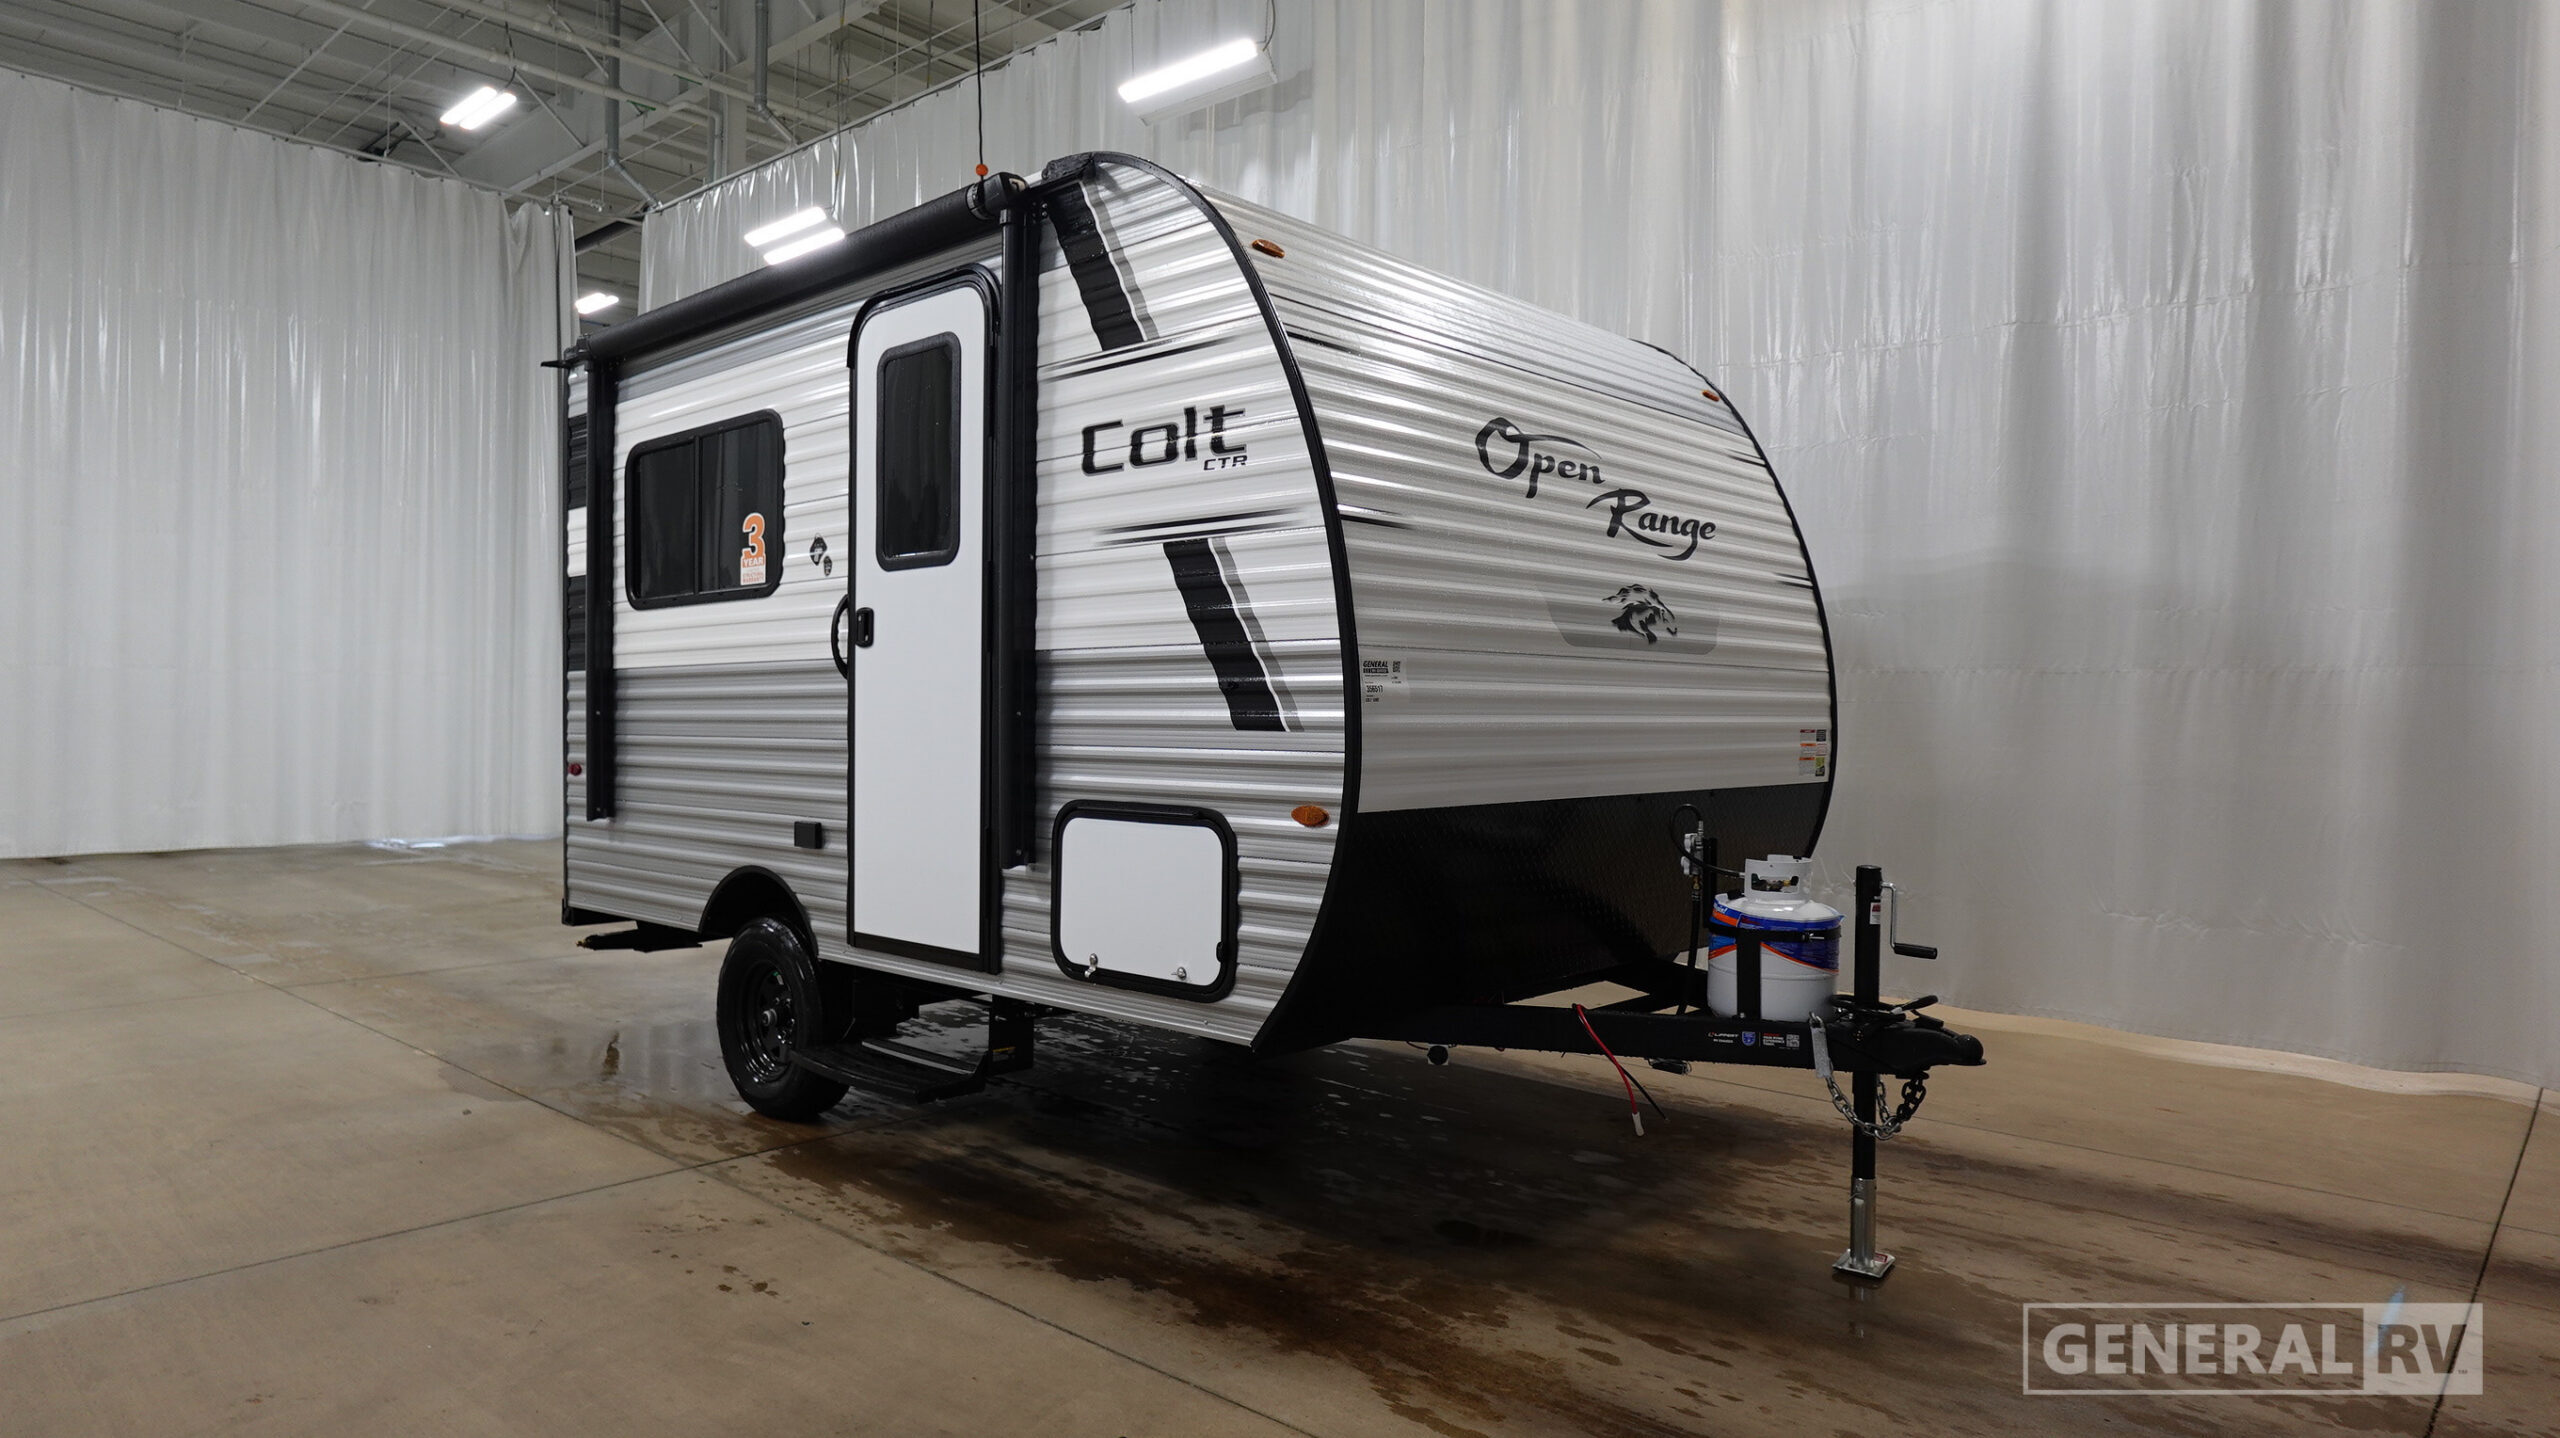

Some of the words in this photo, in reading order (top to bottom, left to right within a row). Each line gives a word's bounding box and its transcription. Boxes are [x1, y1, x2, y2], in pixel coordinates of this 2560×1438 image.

[1082, 405, 1247, 476] Colt
[1203, 455, 1247, 471] CTR
[1475, 417, 1606, 498] Open
[742, 513, 765, 557] 3
[1586, 488, 1716, 561] Range
[744, 557, 764, 567] YEAR
